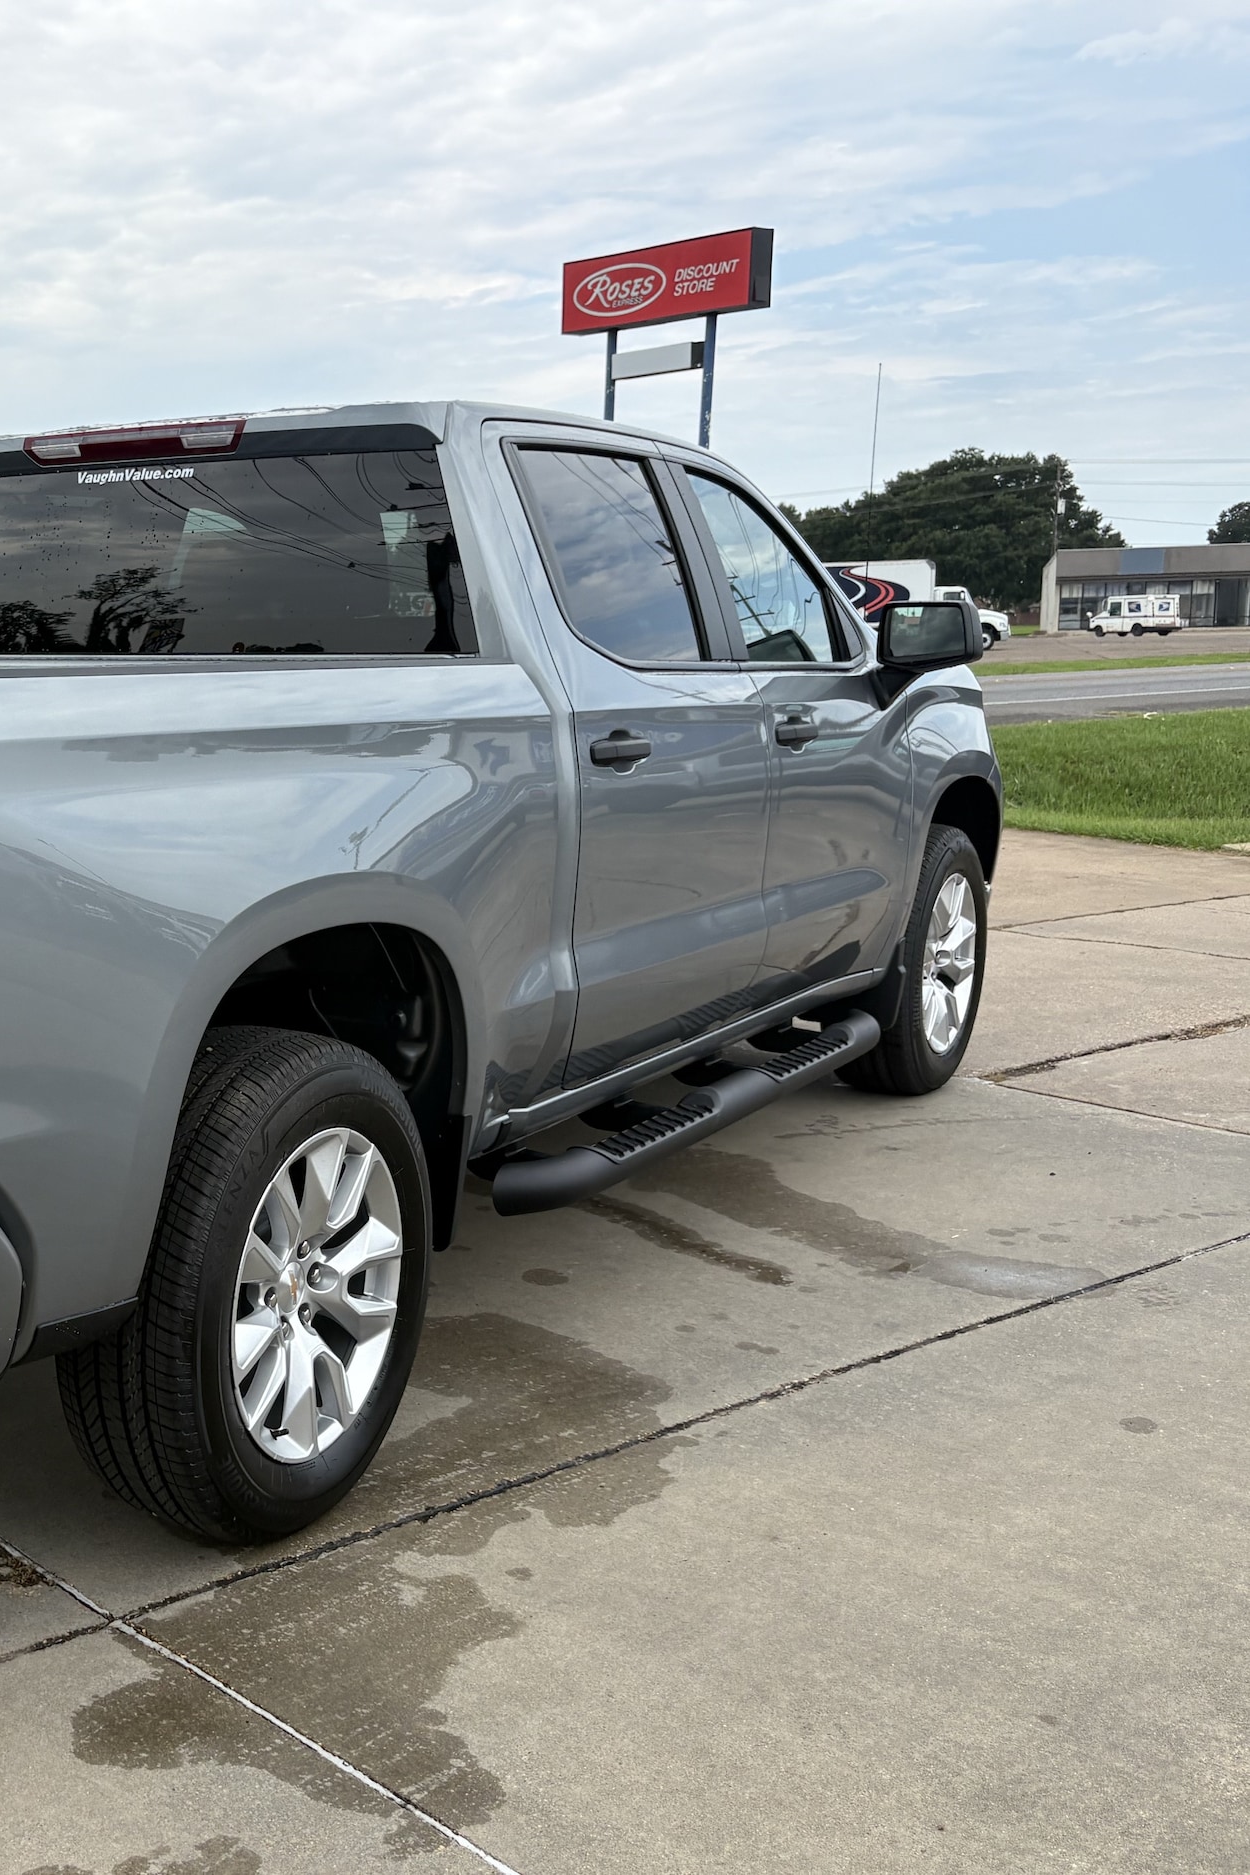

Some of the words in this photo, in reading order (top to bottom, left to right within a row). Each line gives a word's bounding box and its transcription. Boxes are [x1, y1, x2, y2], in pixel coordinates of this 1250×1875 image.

[674, 259, 740, 282] DISCOUNT
[584, 274, 655, 307] ROSES
[673, 277, 716, 297] STORE
[612, 296, 644, 308] EXPRESS
[77, 467, 194, 485] VaughnValue.com
